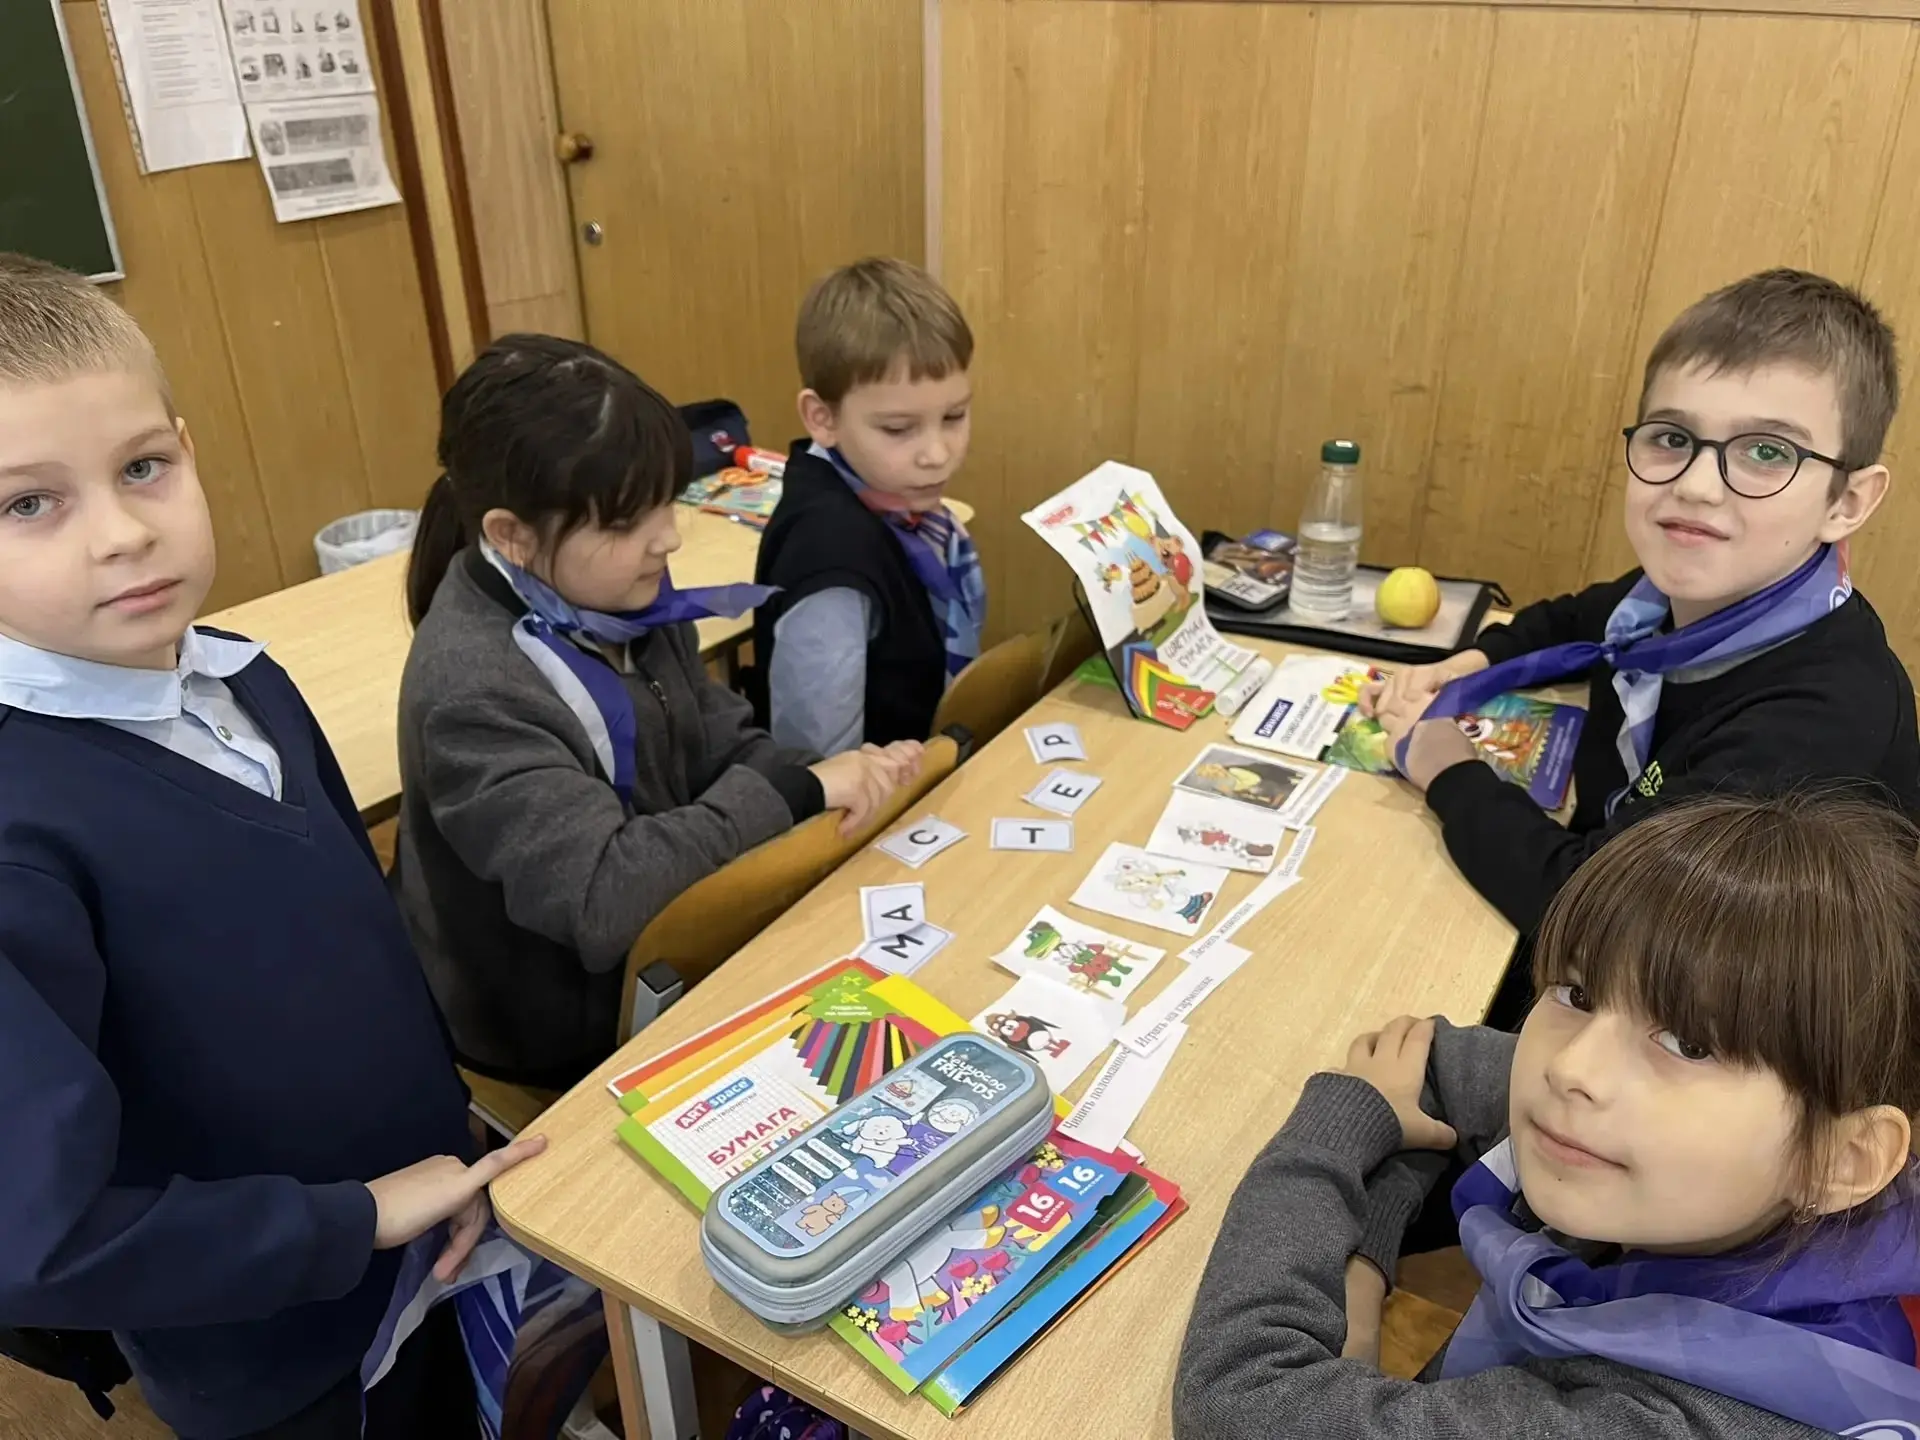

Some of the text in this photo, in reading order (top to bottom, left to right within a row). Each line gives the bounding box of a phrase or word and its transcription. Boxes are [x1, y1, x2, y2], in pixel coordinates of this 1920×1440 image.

[1043, 734, 1072, 746] Р
[1051, 783, 1083, 799] Е
[909, 829, 940, 846] С
[1021, 827, 1045, 844] Т
[881, 904, 914, 922] А
[880, 933, 925, 959] М
[1134, 1019, 1168, 1047] Играть
[1165, 1010, 1178, 1022] на
[930, 1055, 997, 1101] FRIENDS
[1062, 1098, 1095, 1129] Чинить
[706, 1104, 797, 1165] БУМАГА
[1056, 1166, 1095, 1189] 16
[1015, 1192, 1054, 1218] 16
